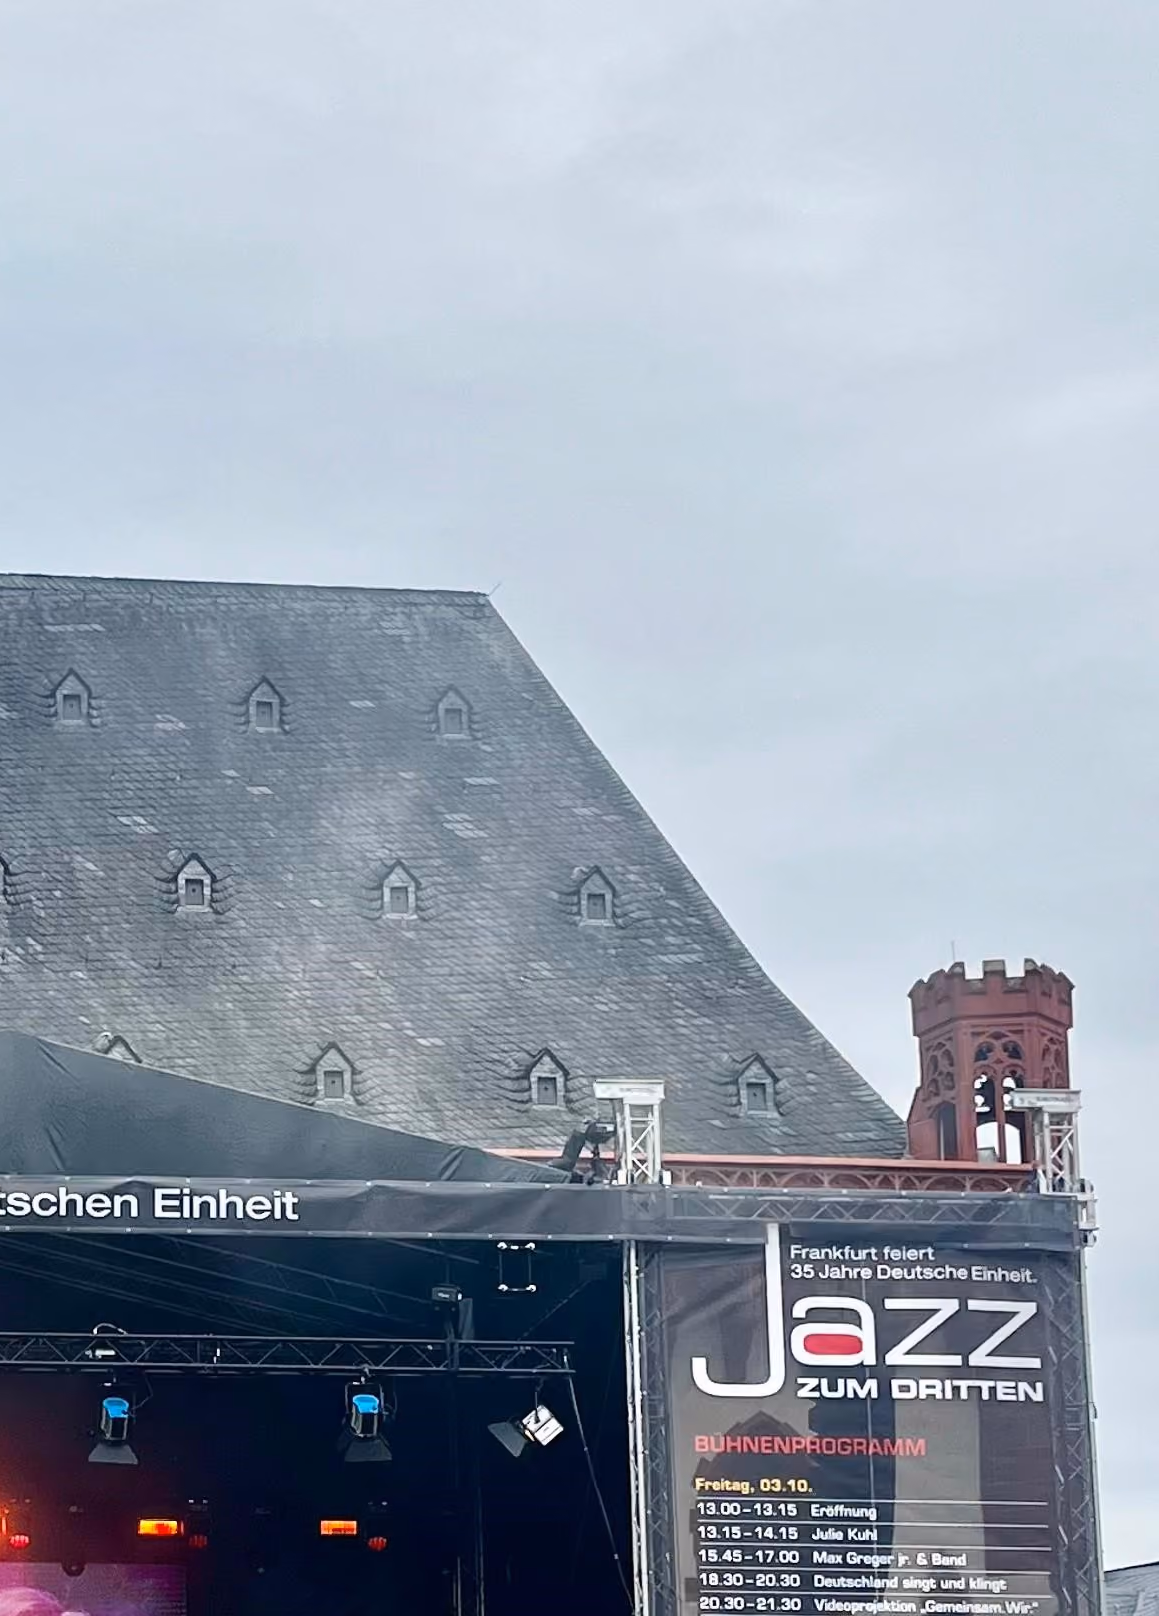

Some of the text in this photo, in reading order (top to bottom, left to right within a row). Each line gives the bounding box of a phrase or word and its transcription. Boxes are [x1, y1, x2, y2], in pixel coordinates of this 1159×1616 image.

[154, 1188, 299, 1221] Einheit
[790, 1245, 935, 1263] Frankfurt feiert
[790, 1264, 1038, 1283] 35 Jahre Deutsche Einheit.
[691, 1222, 1042, 1398] Jazz
[797, 1378, 1043, 1403] ZUM DRITTEN
[695, 1478, 813, 1494] Freitag, 03.10.
[811, 1504, 877, 1520] Eröffnung
[812, 1528, 844, 1541] Julie
[848, 1528, 877, 1541] Kuhl
[813, 1552, 843, 1564] Max
[846, 1552, 895, 1567] Greger
[916, 1553, 928, 1565] &
[932, 1553, 967, 1566] Band
[814, 1575, 898, 1589] Deutschland
[902, 1577, 937, 1592] singt
[941, 1578, 965, 1589] und
[969, 1577, 1007, 1593] klingt
[814, 1598, 916, 1614] Videoprojektion
